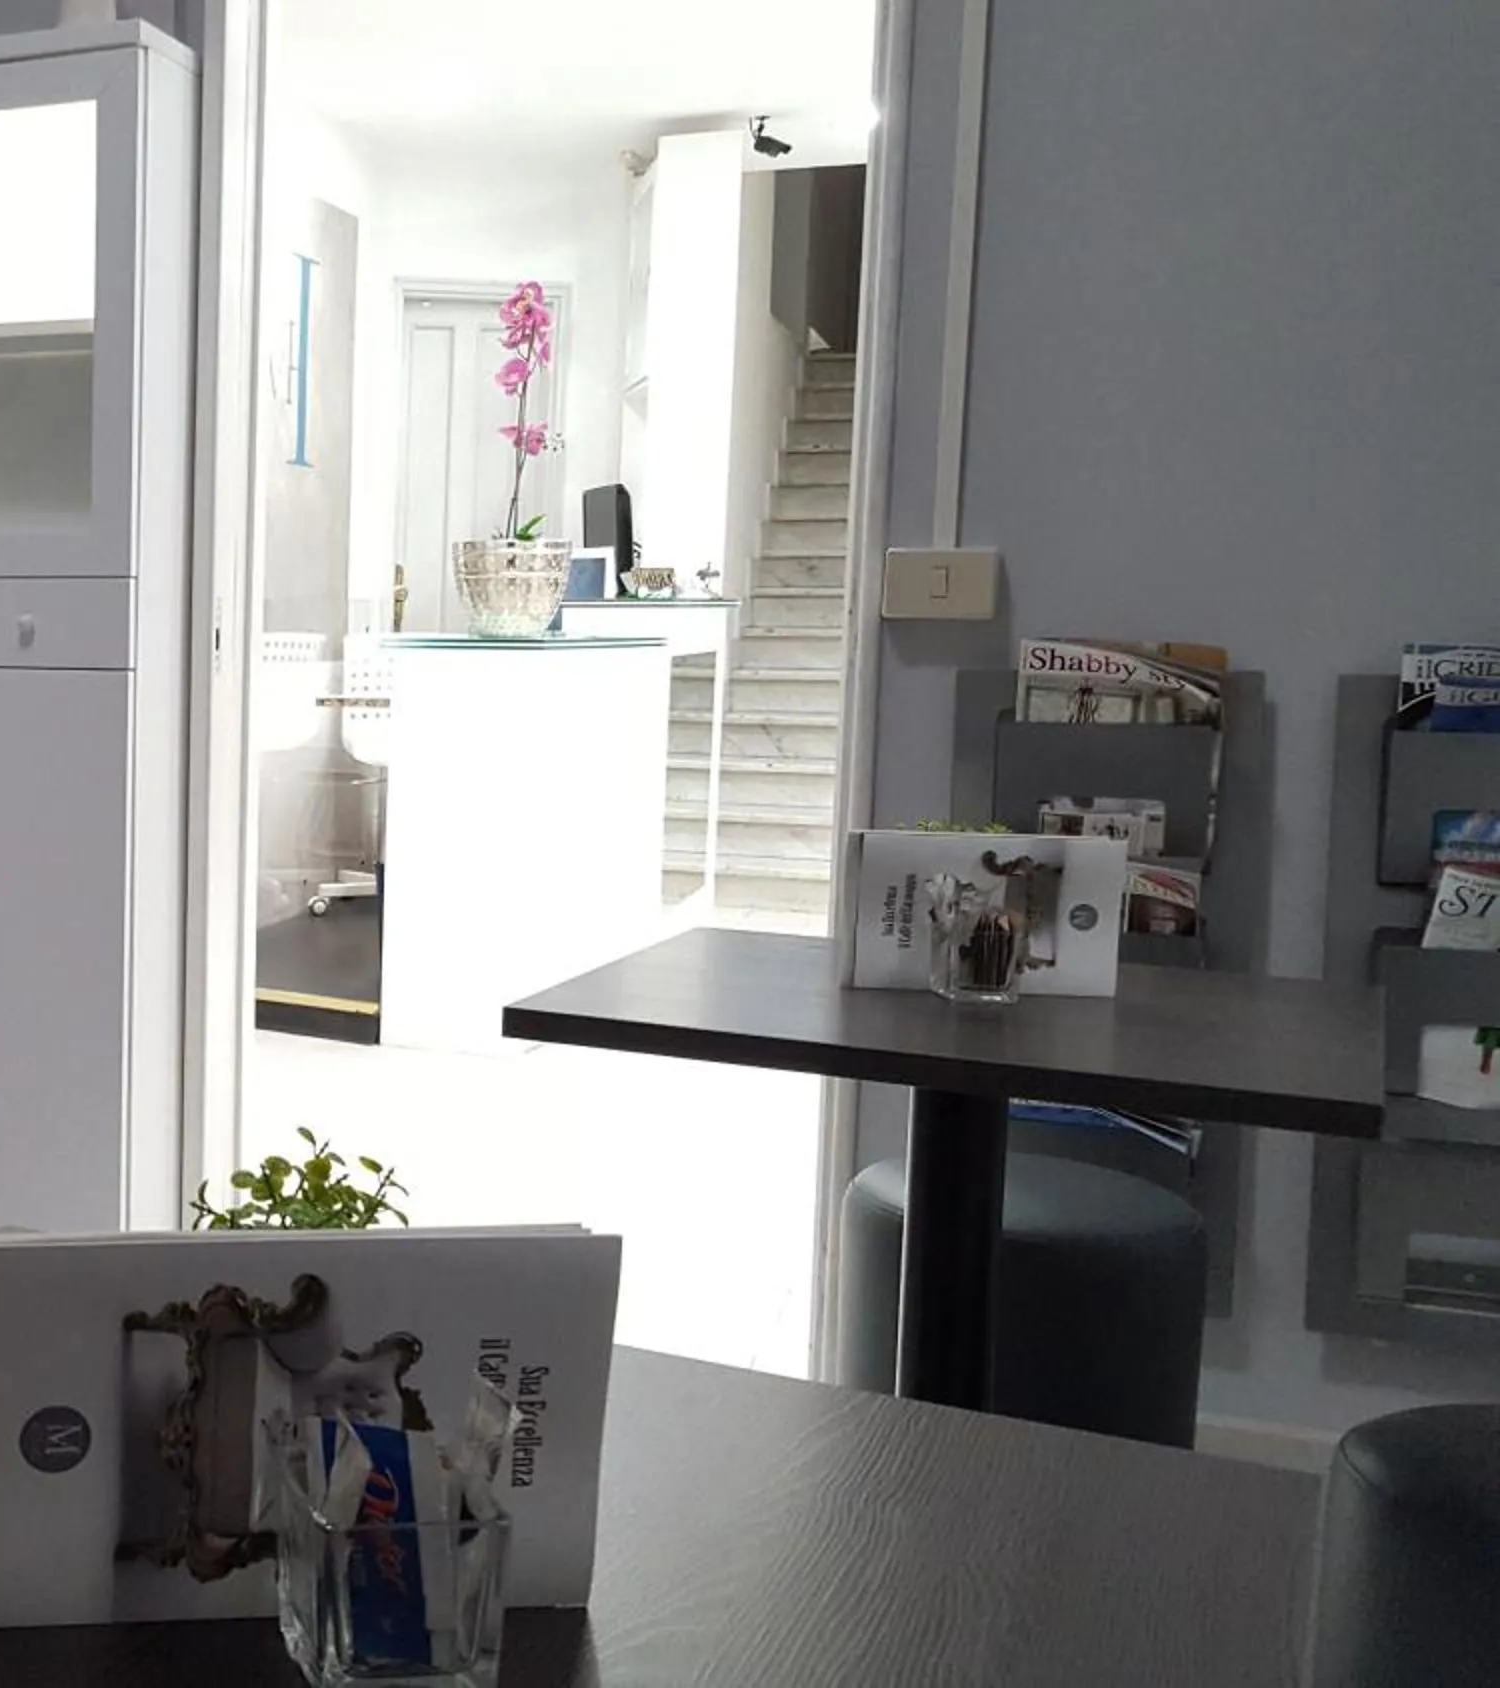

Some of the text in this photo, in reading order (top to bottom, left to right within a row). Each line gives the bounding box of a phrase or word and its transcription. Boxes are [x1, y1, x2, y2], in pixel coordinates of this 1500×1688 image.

[1029, 646, 1137, 685] Shabby
[510, 1366, 550, 1488] Sua Eccellenza
